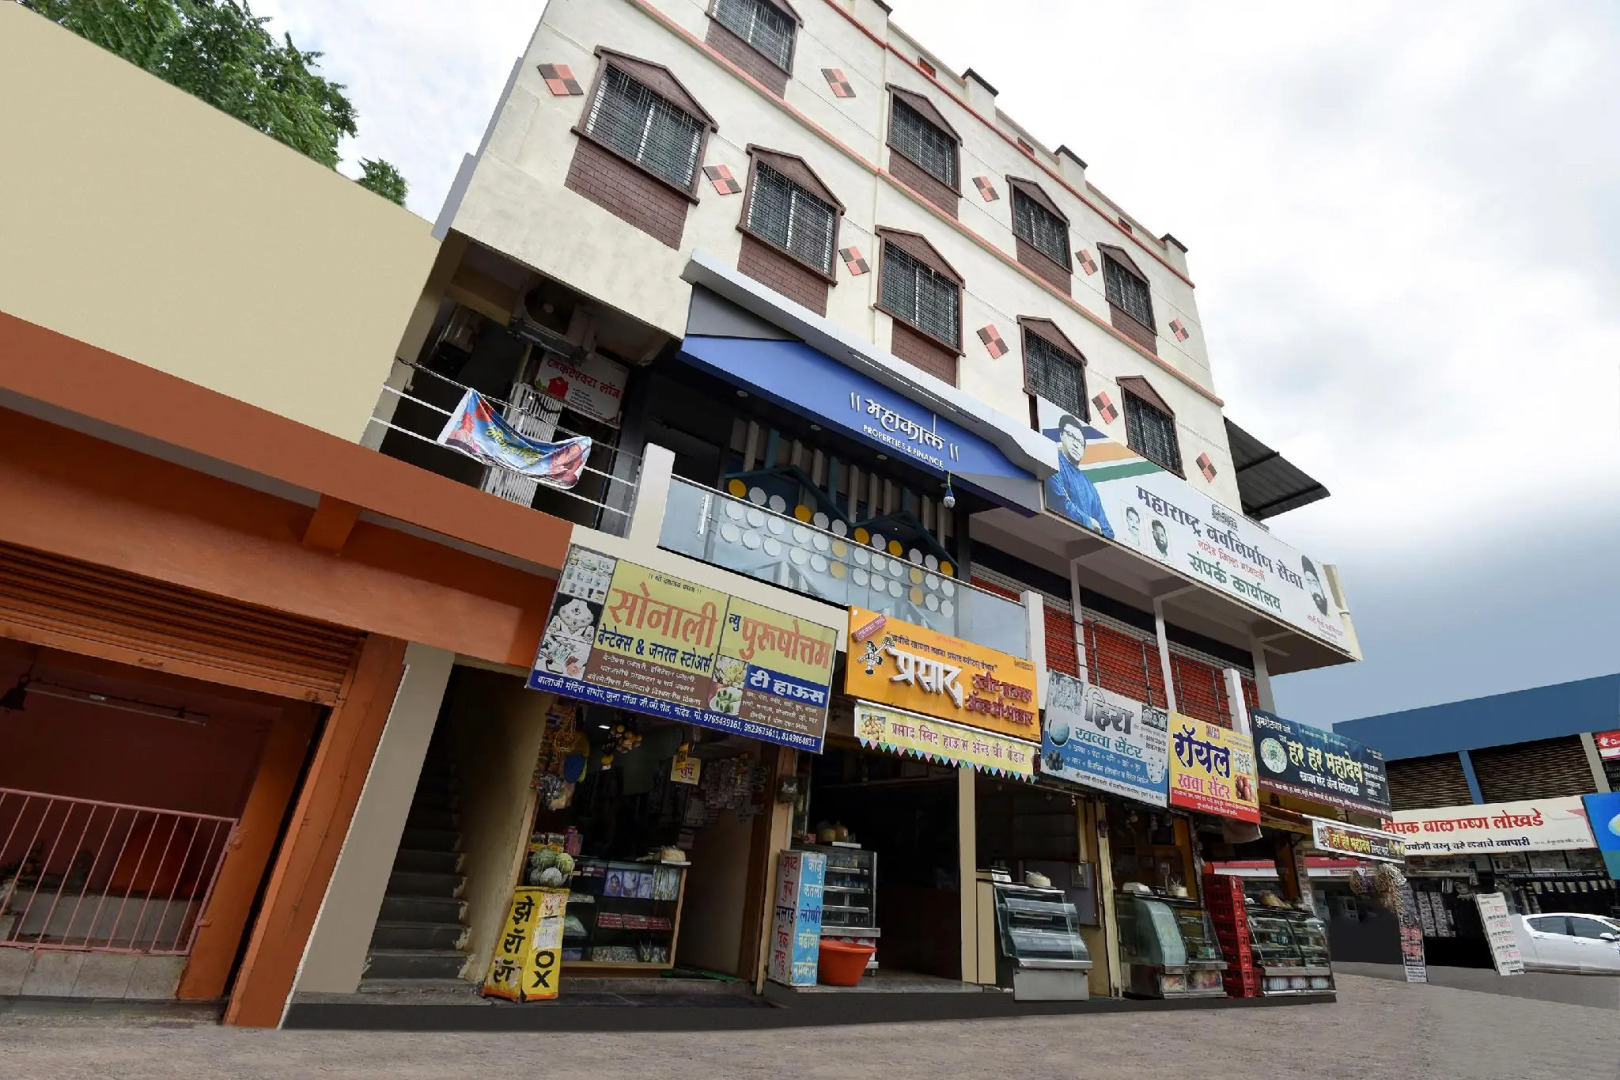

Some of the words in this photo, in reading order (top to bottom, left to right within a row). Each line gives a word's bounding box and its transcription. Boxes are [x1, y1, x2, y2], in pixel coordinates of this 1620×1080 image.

[863, 424, 906, 449] PROPERTIES
[906, 445, 912, 454] &
[912, 448, 944, 468] FINANCE
[865, 398, 946, 451] महाकाल
[1136, 485, 1202, 538] महाराष्ट्र
[1204, 522, 1274, 574] नवनिर्माण
[1187, 551, 1228, 584] संपर्क
[1230, 572, 1282, 612] कार्यालय
[608, 581, 719, 648] सोनाली
[635, 639, 645, 655] &
[649, 642, 679, 664] जनरल
[680, 648, 714, 673] स्टोअर्स
[884, 646, 963, 709] प्रसाद
[537, 675, 563, 689] बालाजी
[750, 670, 770, 689] टी
[773, 680, 825, 703] हाऊस
[891, 722, 915, 739] प्रसाद
[1084, 686, 1134, 735] हिरा
[1114, 736, 1143, 758] सेंटर
[1173, 724, 1230, 778] रॉयल
[1287, 741, 1306, 767] हर
[1306, 746, 1325, 773] हर
[1325, 750, 1363, 783] महादेव
[1177, 773, 1204, 793] खवा
[1208, 776, 1230, 799] सेंटर
